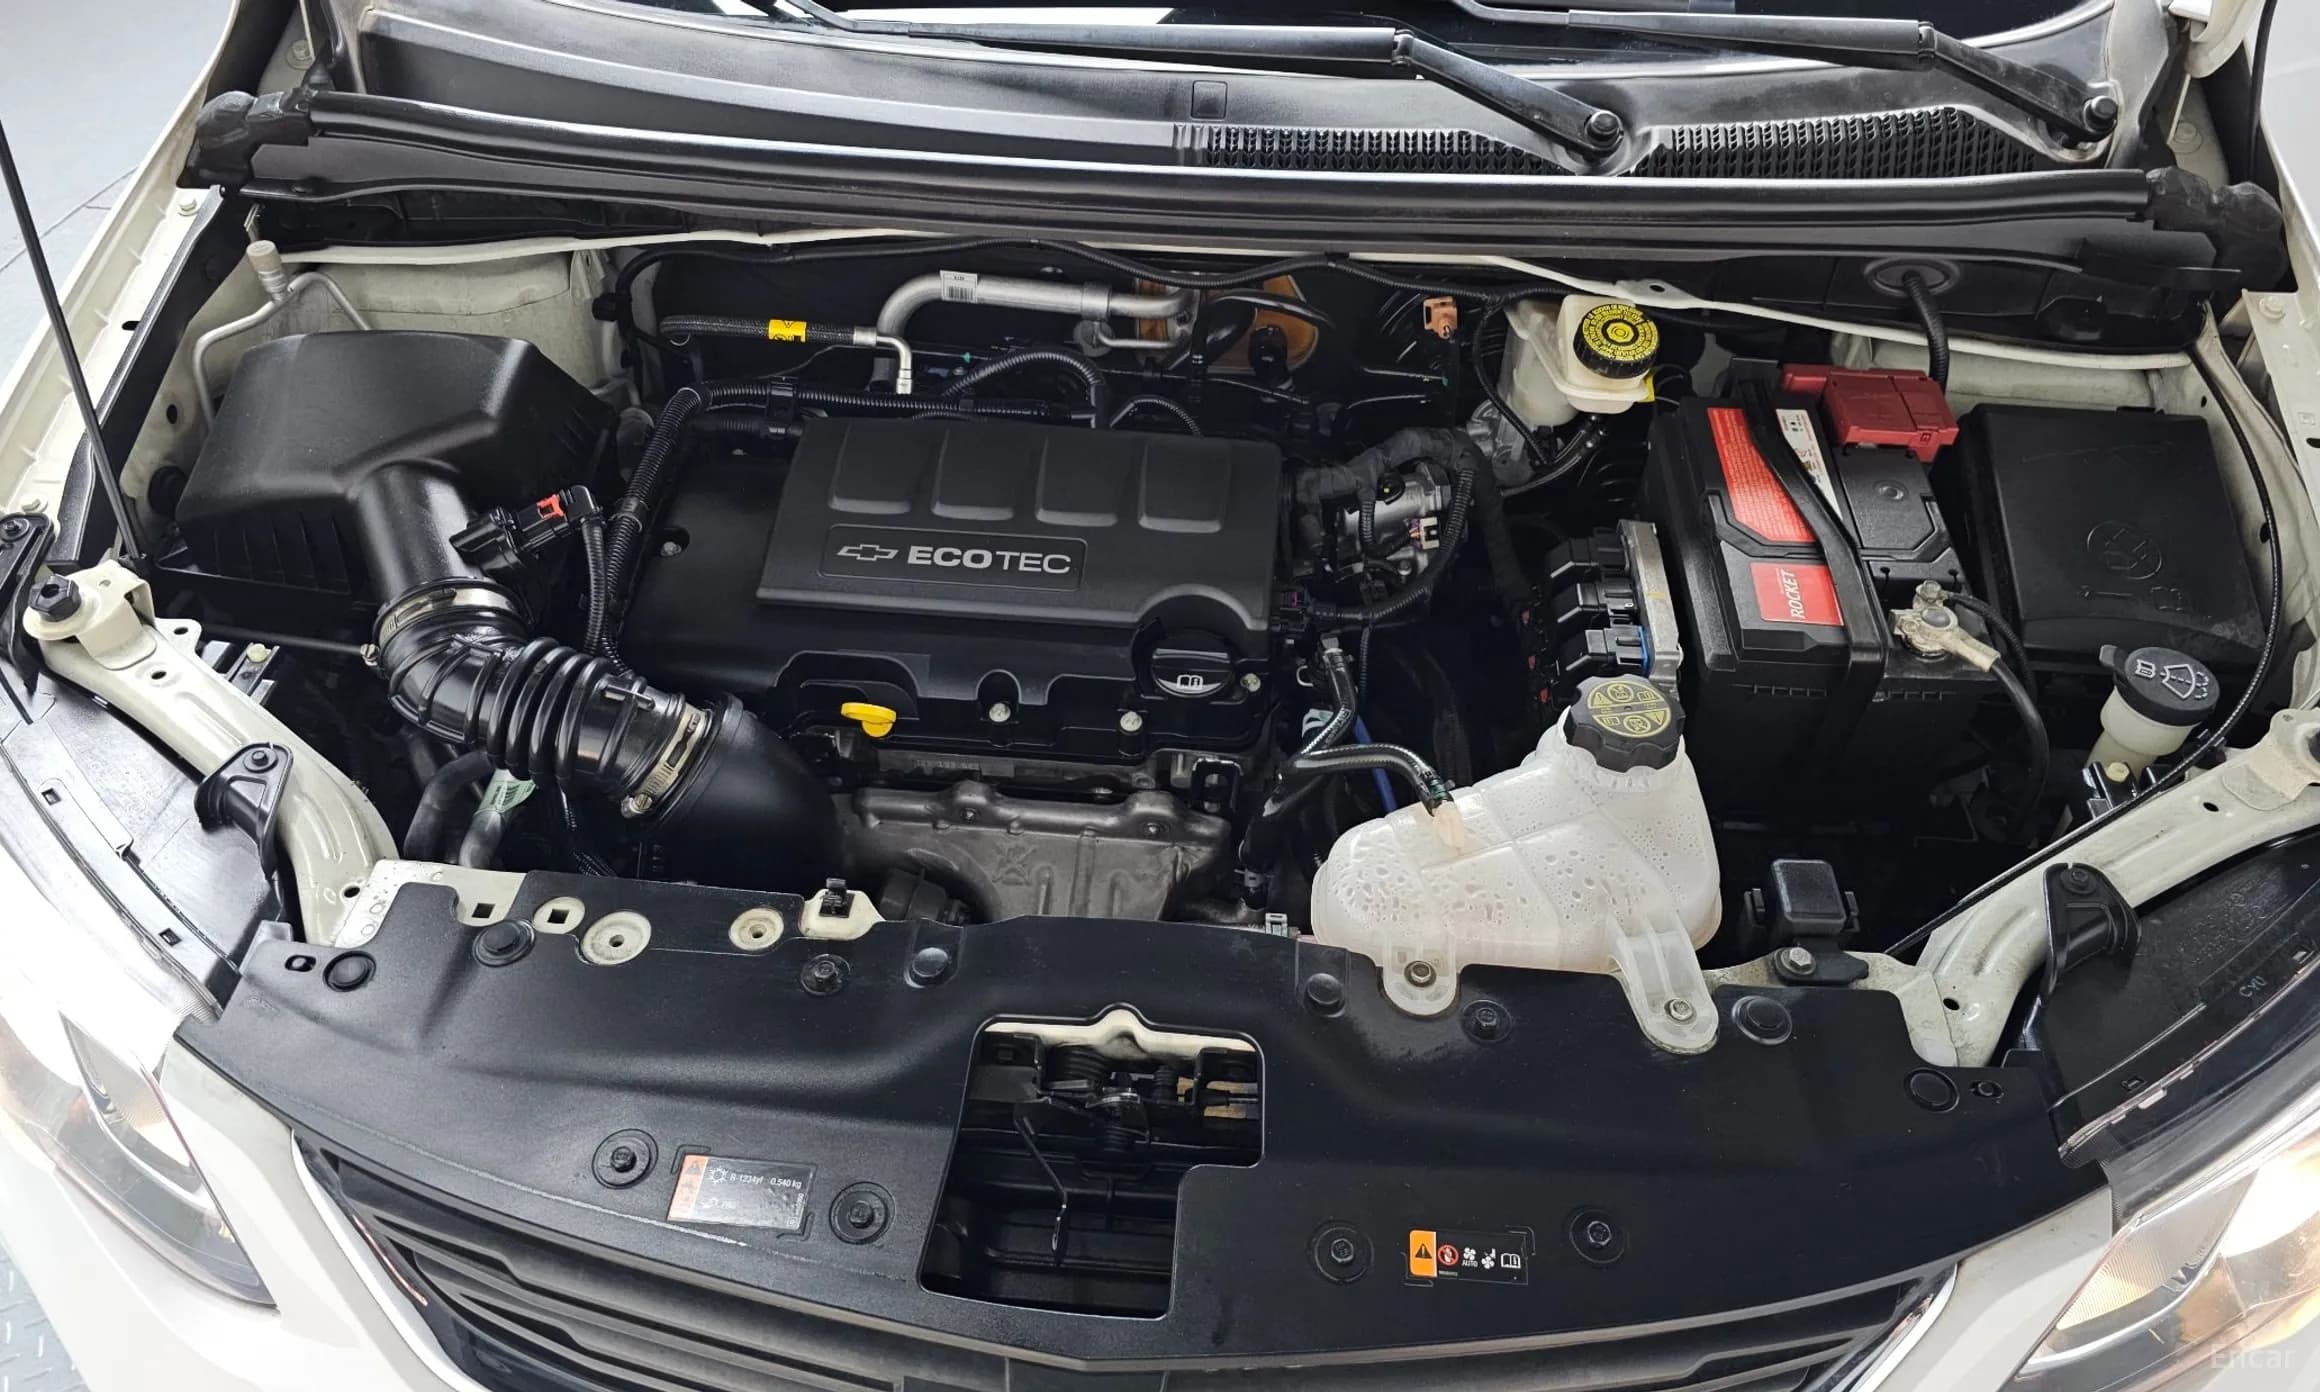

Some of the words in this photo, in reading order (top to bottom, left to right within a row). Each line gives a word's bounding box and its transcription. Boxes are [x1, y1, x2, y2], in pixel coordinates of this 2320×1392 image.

[907, 545, 1071, 574] ECOTEC
[1780, 569, 1806, 619] ROCKET
[770, 1178, 791, 1188] 0.540
[792, 1180, 802, 1190] kg
